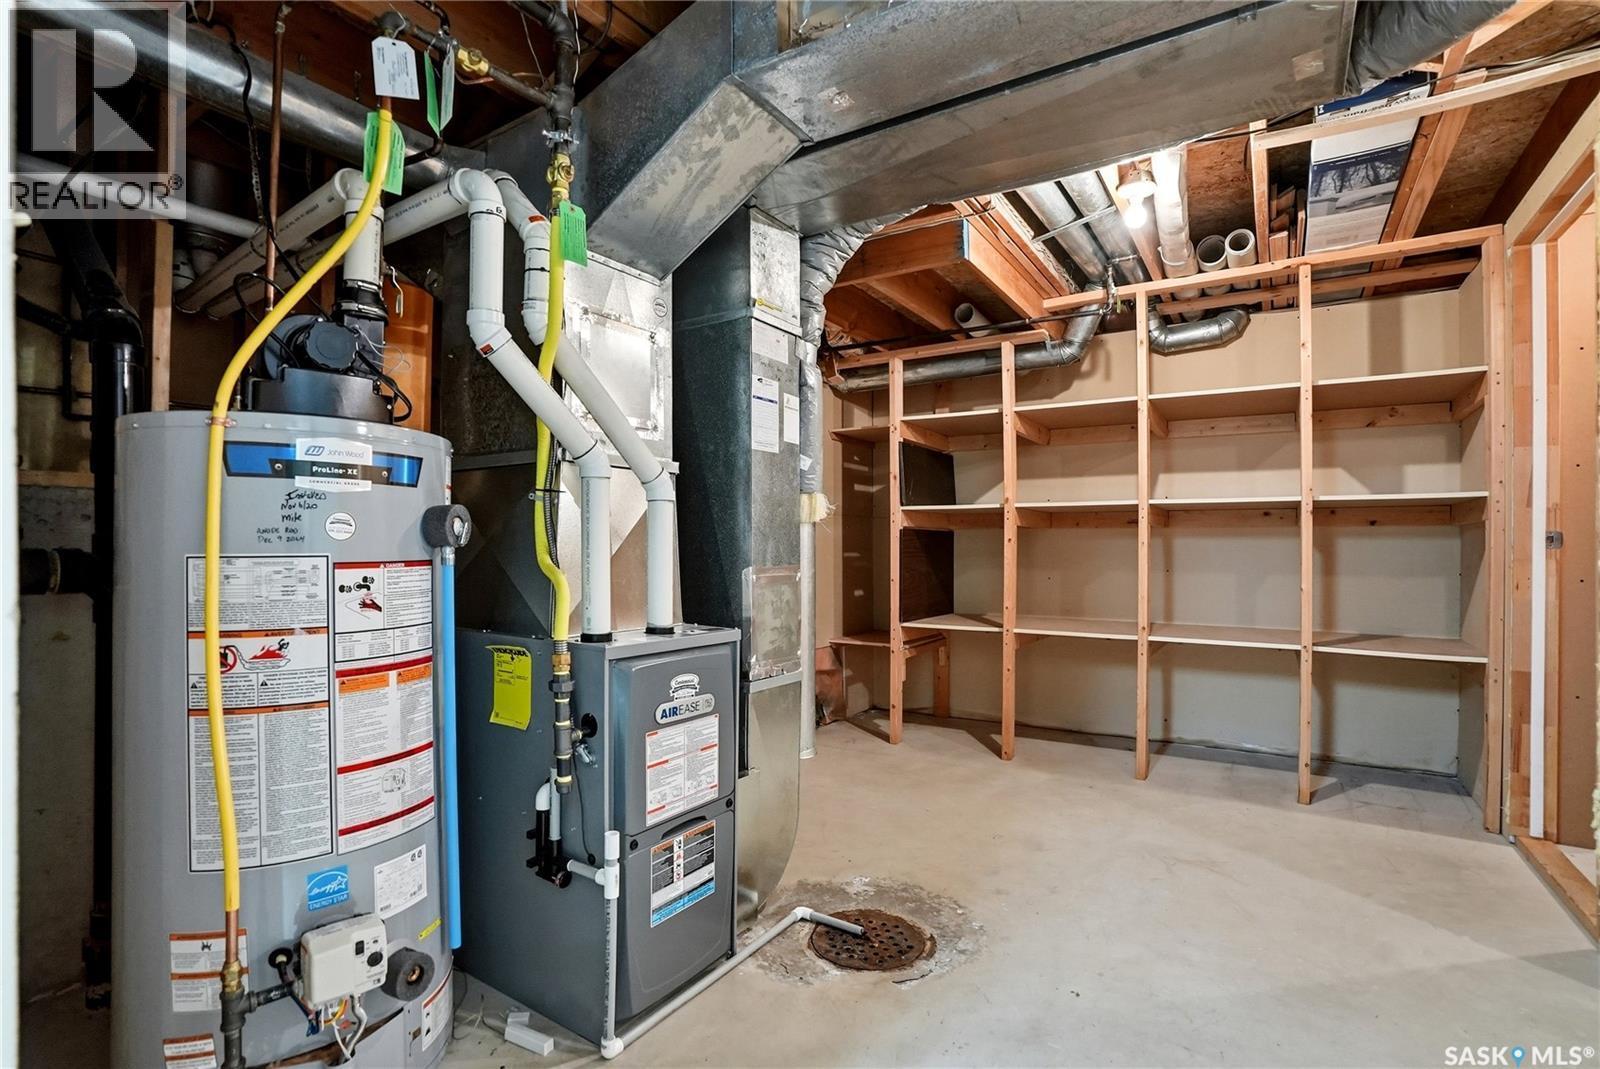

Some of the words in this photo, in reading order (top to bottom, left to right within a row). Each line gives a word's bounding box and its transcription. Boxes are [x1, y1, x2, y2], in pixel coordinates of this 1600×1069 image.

[327, 449, 344, 457] John
[345, 450, 365, 459] Wood
[347, 468, 358, 476] XE
[660, 700, 701, 720] AIREASE
